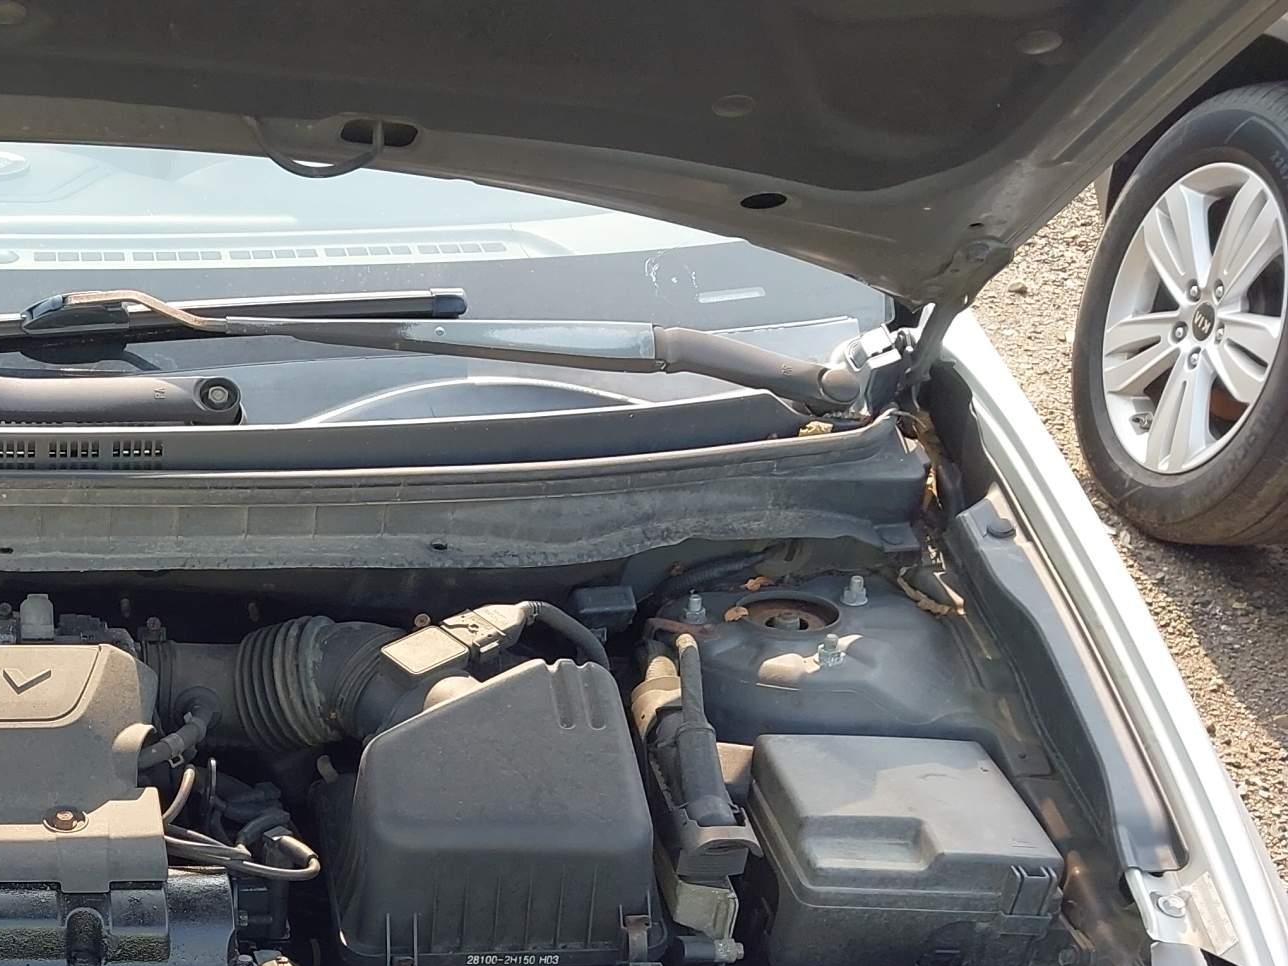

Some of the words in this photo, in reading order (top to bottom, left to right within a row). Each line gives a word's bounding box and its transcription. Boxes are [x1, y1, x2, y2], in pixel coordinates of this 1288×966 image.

[1194, 311, 1211, 334] KIA
[467, 955, 535, 965] 28100-2H150
[539, 955, 559, 965] H03
